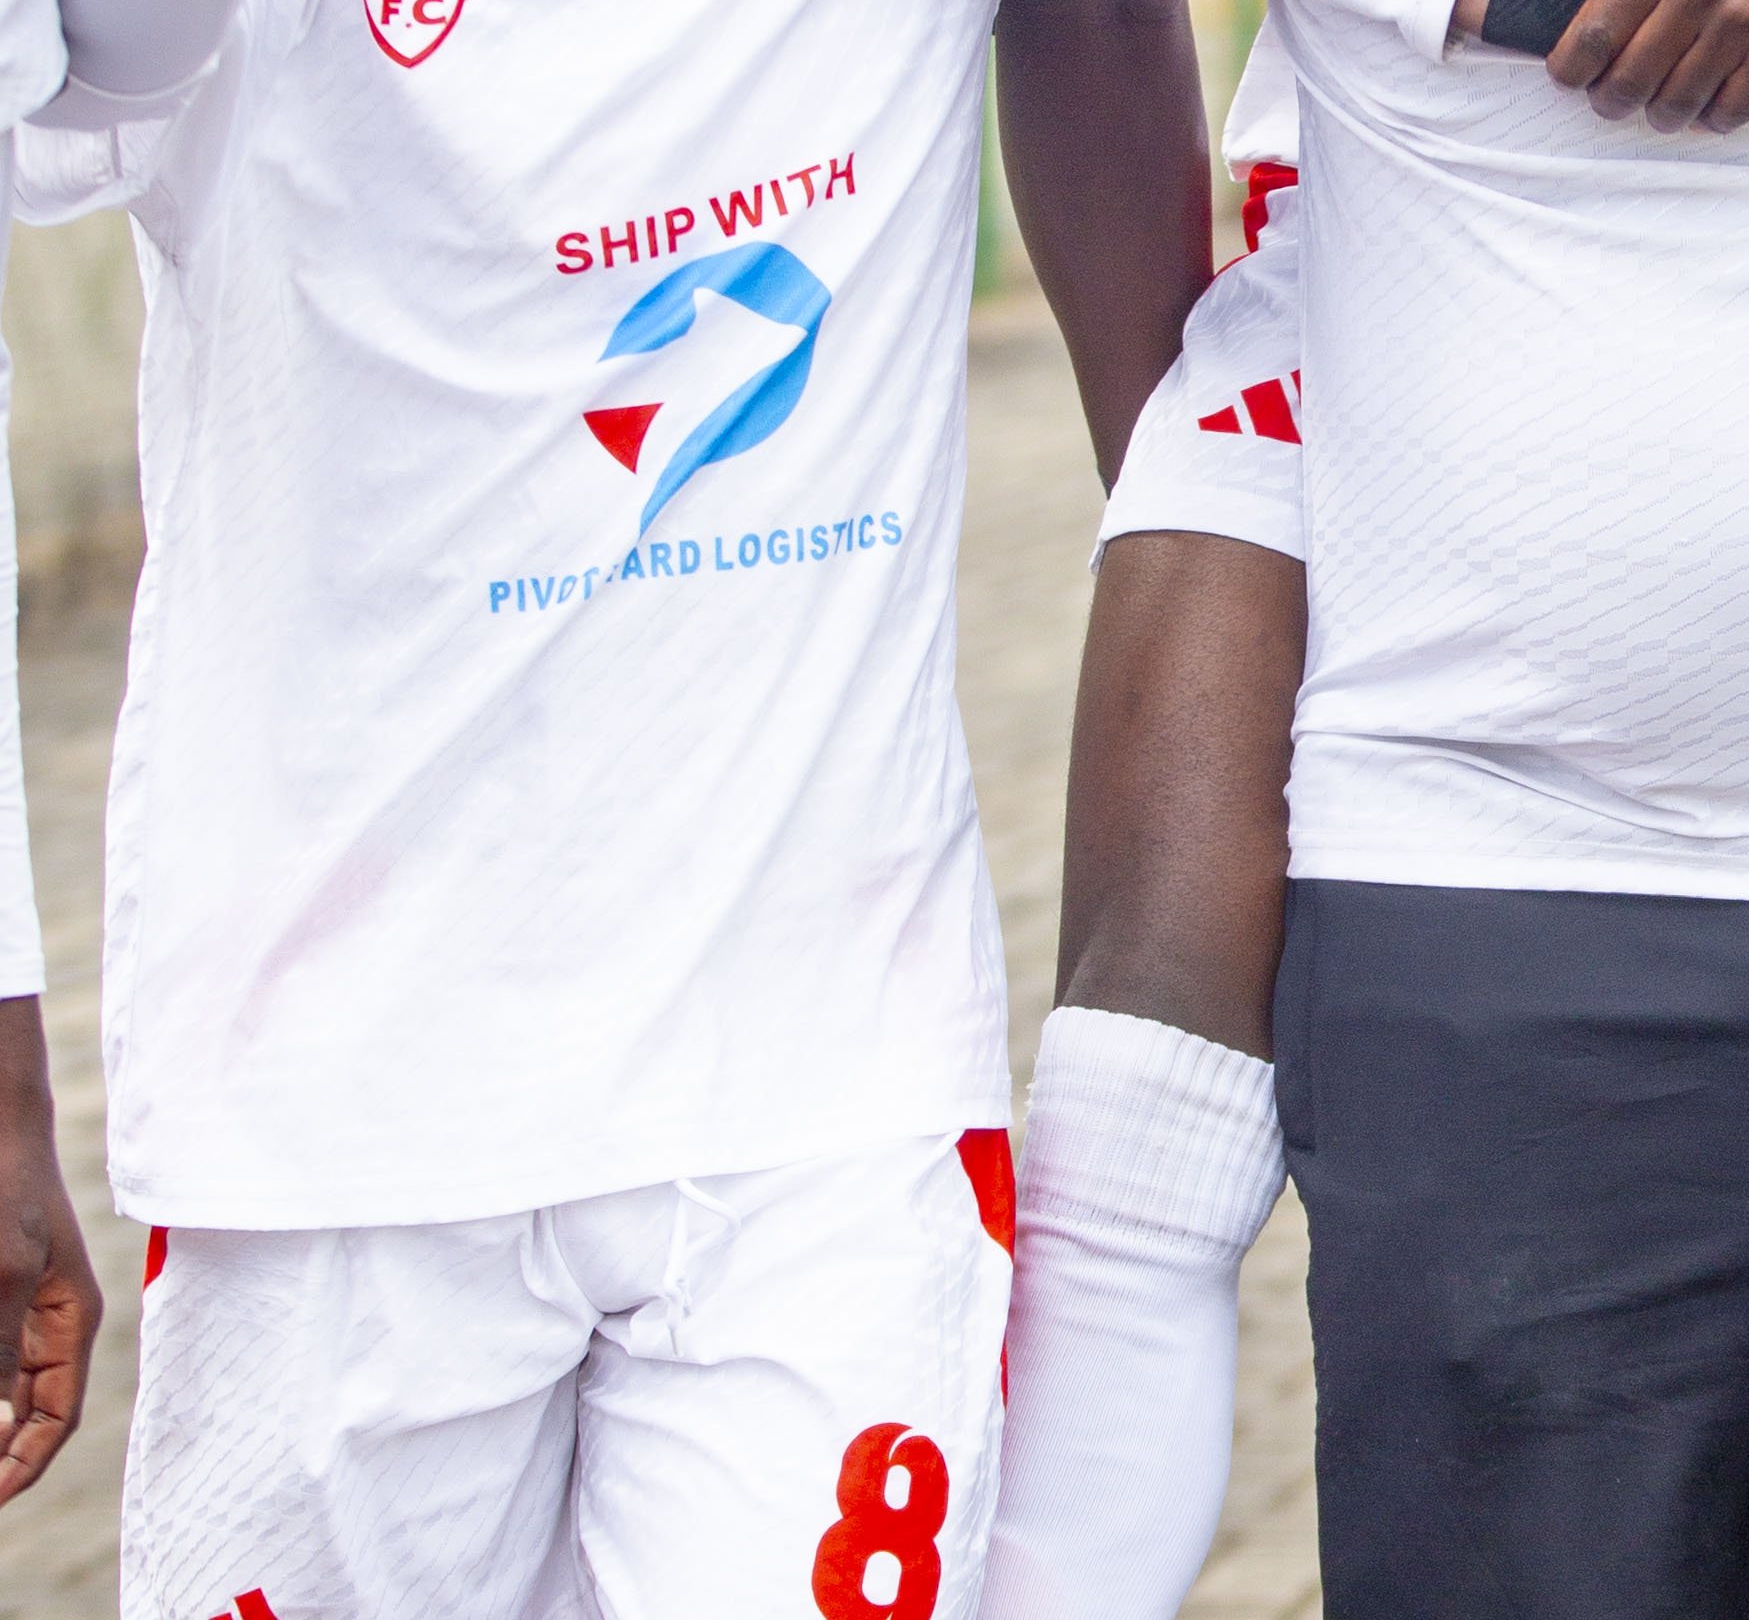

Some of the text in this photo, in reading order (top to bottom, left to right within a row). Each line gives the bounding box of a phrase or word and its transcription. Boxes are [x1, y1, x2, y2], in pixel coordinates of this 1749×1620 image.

[556, 152, 857, 275] SHIP WITH
[715, 510, 903, 572] LOGISTICS
[811, 1422, 950, 1620] 8
